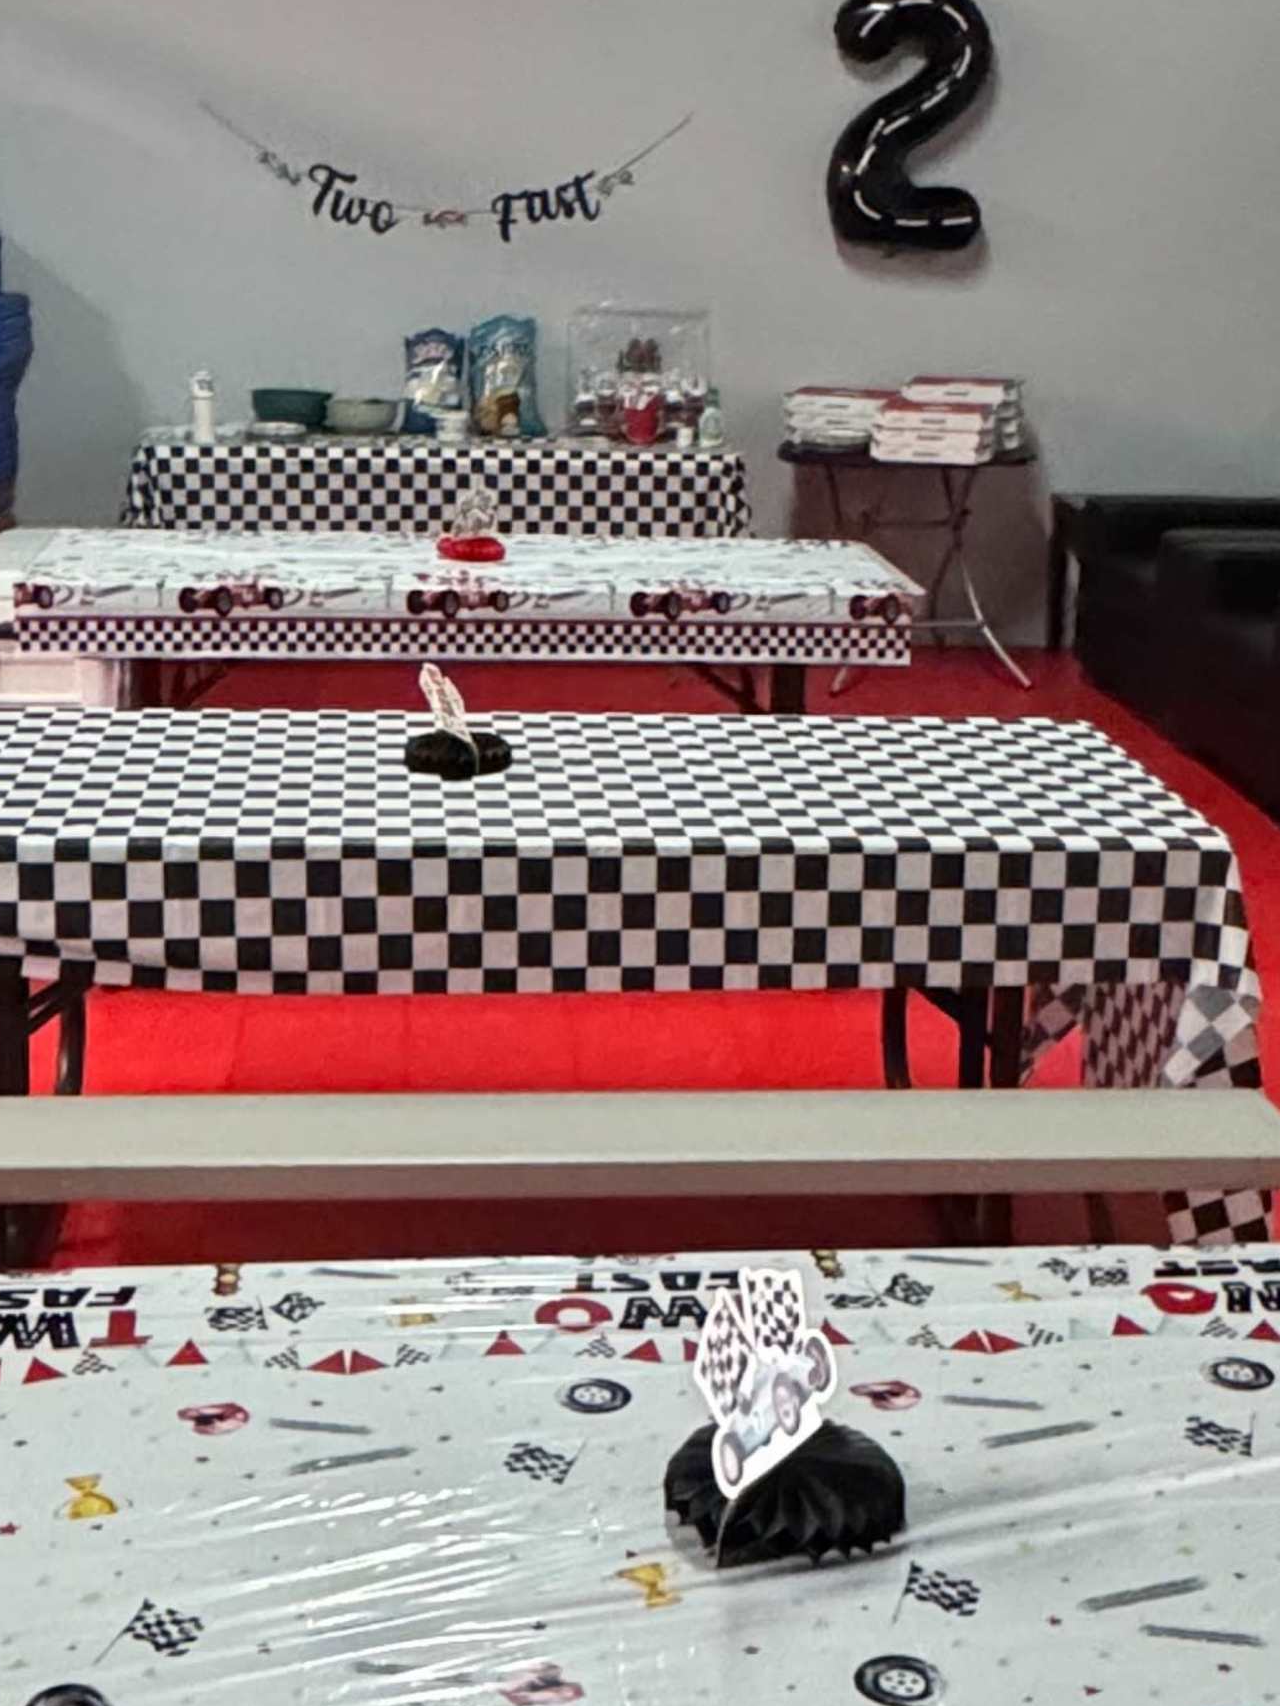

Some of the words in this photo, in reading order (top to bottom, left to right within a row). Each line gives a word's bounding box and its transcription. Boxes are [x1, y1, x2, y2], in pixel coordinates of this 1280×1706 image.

[308, 164, 398, 234] Two
[491, 171, 600, 242] Fast
[534, 1296, 710, 1333] WO
